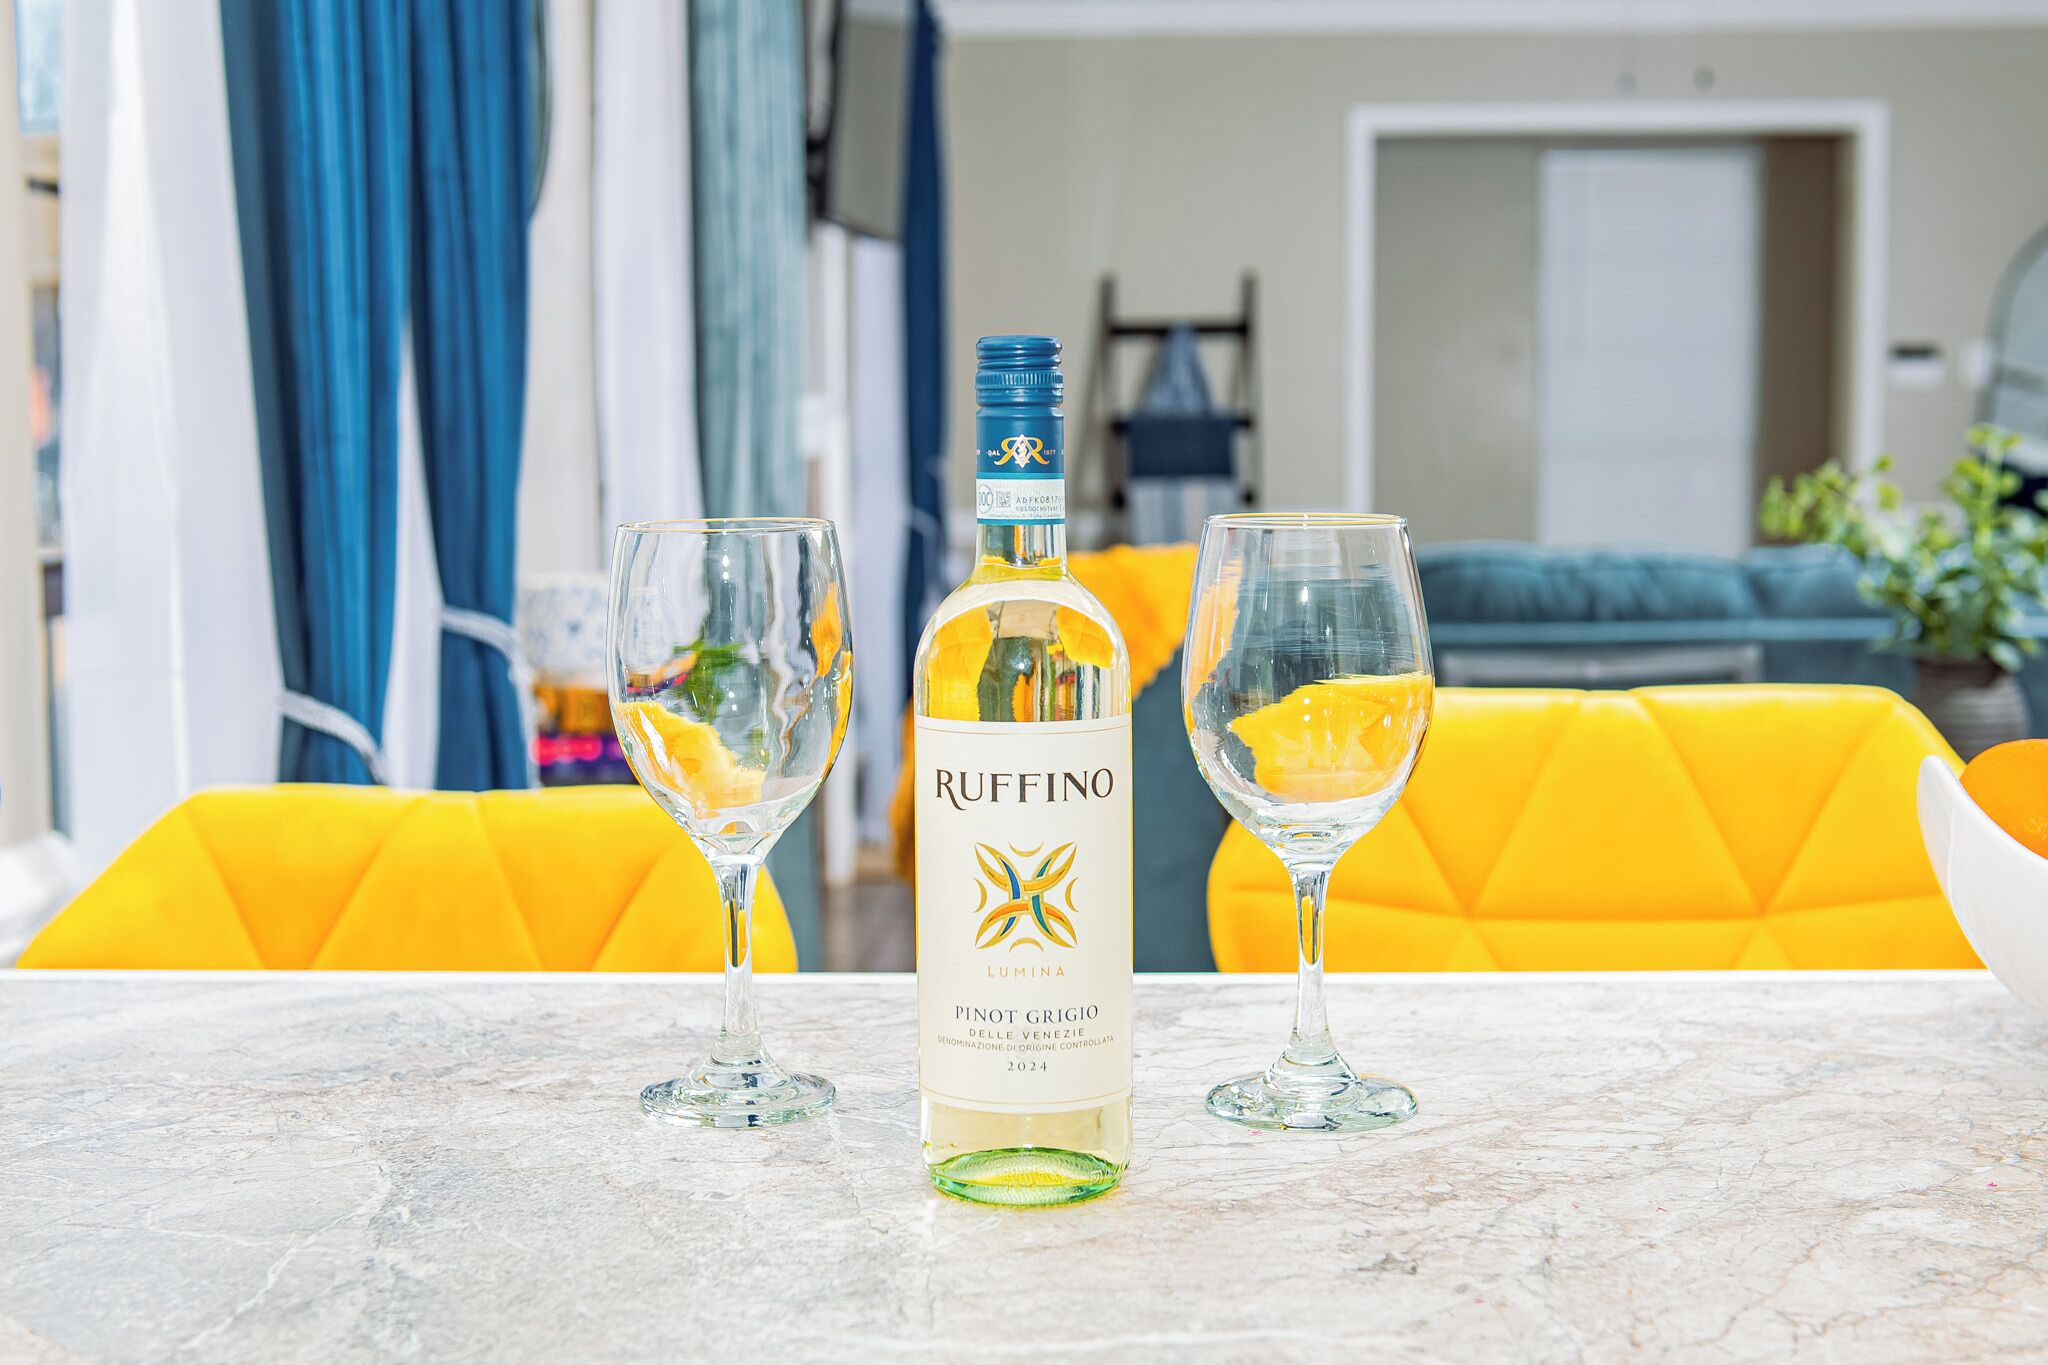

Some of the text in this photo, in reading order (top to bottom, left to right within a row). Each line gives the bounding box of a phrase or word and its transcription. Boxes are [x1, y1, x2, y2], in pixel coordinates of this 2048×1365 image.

[936, 768, 1114, 811] RUFFINO
[987, 965, 1065, 978] LUMINA
[955, 1004, 1099, 1025] PINOT GRIGIO
[969, 1027, 1085, 1040] DELLE VENEZIE
[937, 1034, 1115, 1052] DENOMINAZIONE DI ORIGINE CONTROLLATA
[1007, 1061, 1048, 1072] 2024
